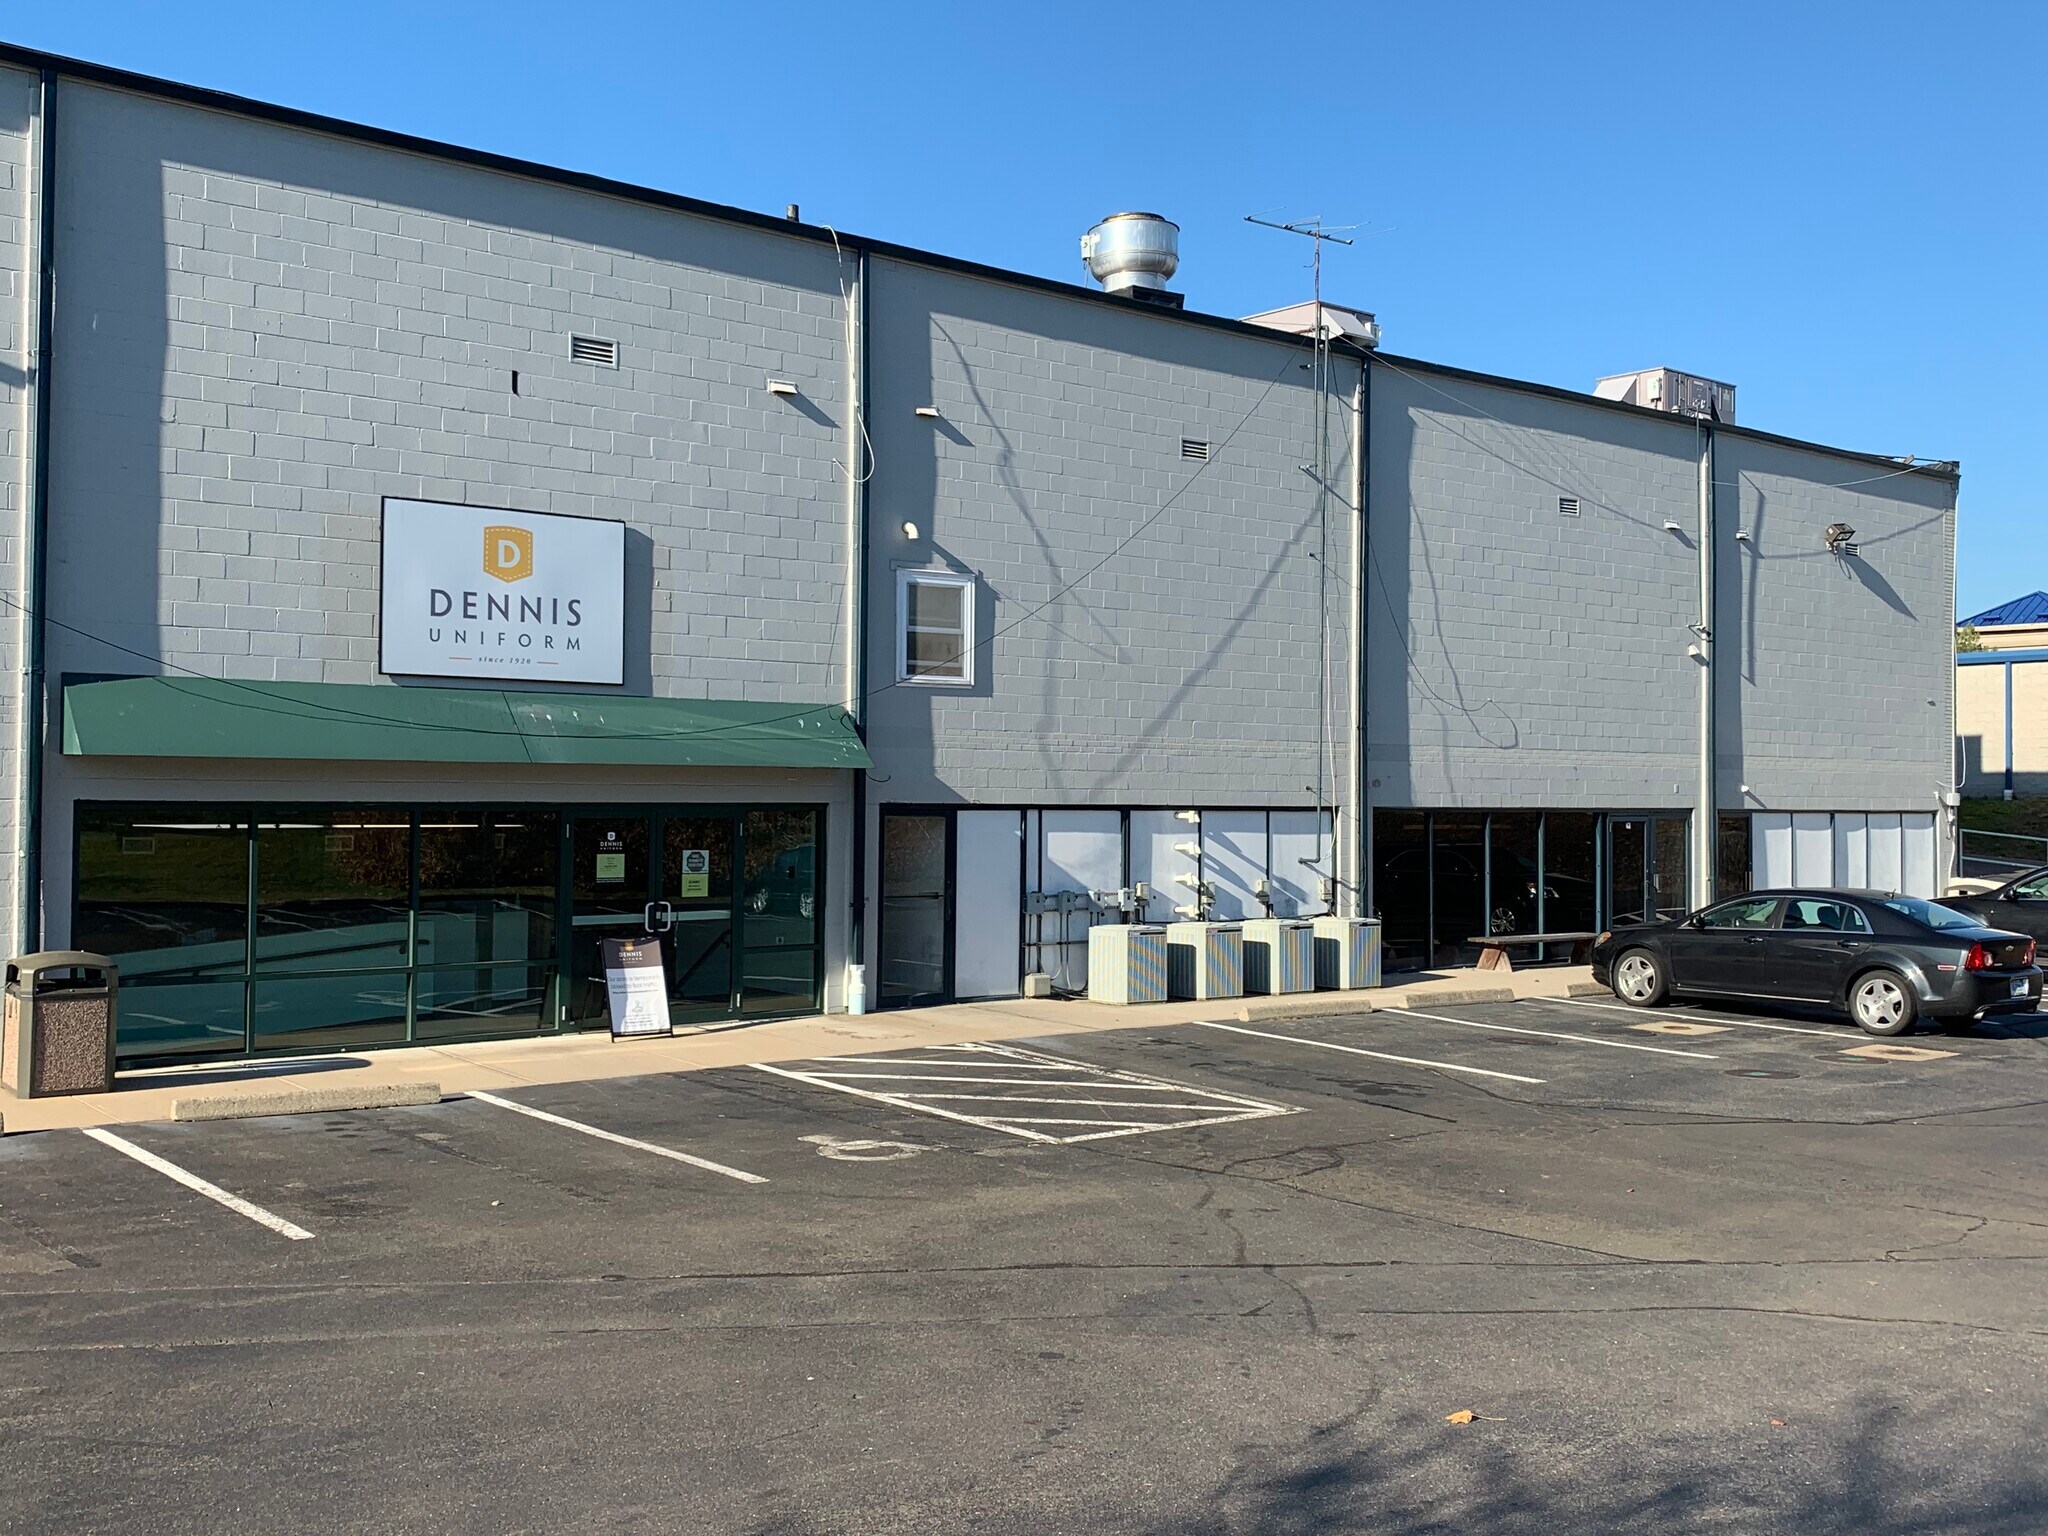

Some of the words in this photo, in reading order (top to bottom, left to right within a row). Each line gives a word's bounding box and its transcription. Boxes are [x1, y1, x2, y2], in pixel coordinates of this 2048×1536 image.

[497, 539, 521, 569] D
[429, 588, 582, 627] DENNIS
[429, 628, 581, 651] UNIFORM
[478, 655, 504, 664] since
